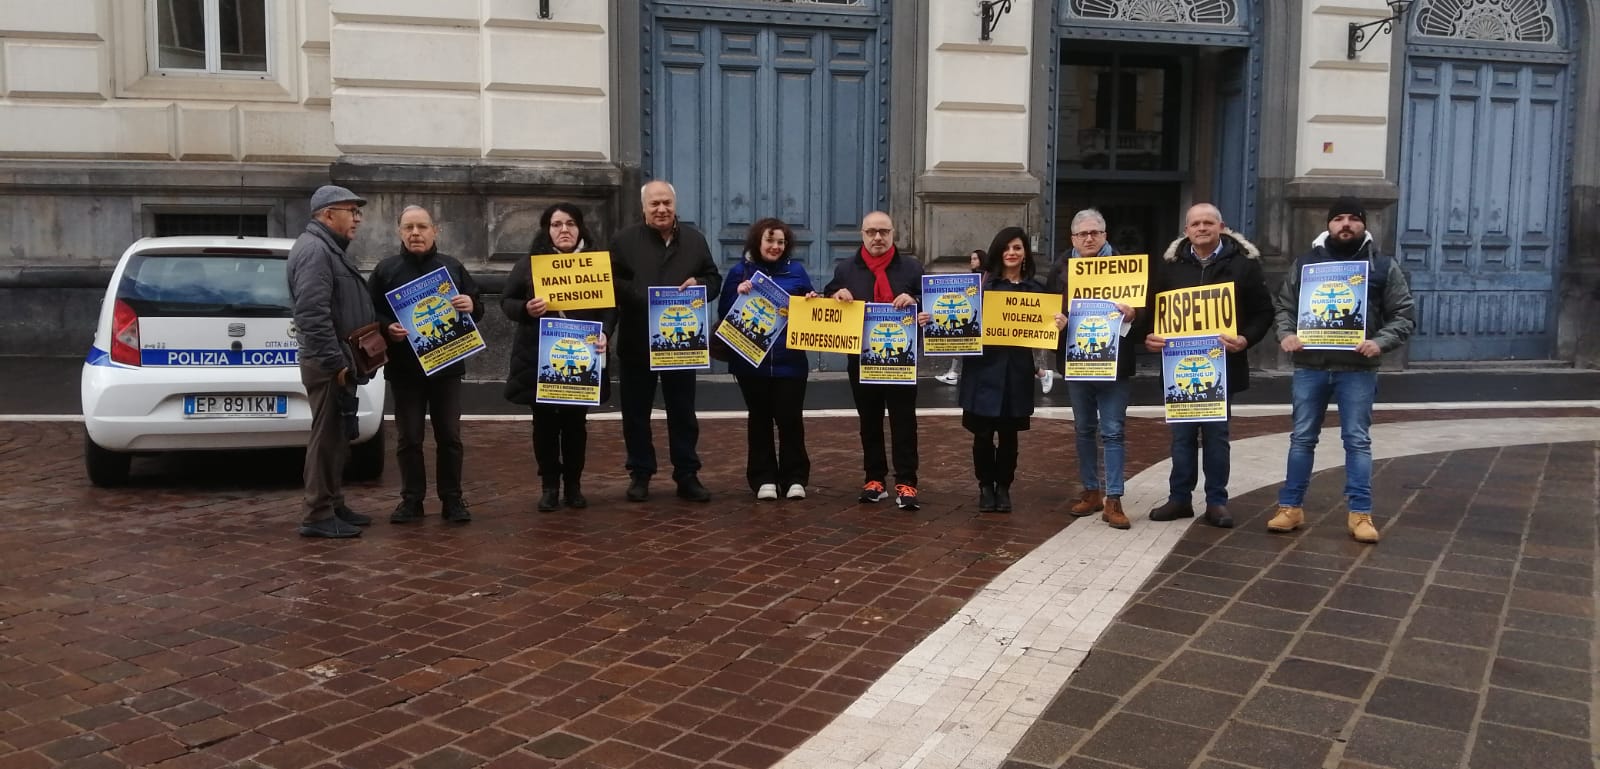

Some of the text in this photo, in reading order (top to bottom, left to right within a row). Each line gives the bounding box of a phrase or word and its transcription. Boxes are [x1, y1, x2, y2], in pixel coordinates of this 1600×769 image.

[552, 258, 592, 269] GIU' LE
[1075, 259, 1142, 275] STIPENDI
[542, 273, 610, 286] MANI DALLE
[549, 290, 603, 302] PENSIONI
[1073, 285, 1144, 299] ADEGUATI
[1006, 297, 1040, 307] NO ALLA
[812, 308, 842, 323] NO EROI
[1158, 287, 1232, 334] RISPETTO
[416, 308, 452, 328] NURSING UP
[1002, 312, 1043, 323] VIOLENZA
[986, 328, 1057, 340] SUGLI OPERATORI
[791, 332, 860, 350] SI PROFESSIONISTI
[168, 352, 300, 365] POLIZIA LOCALE
[196, 397, 276, 412] EP 891KW
